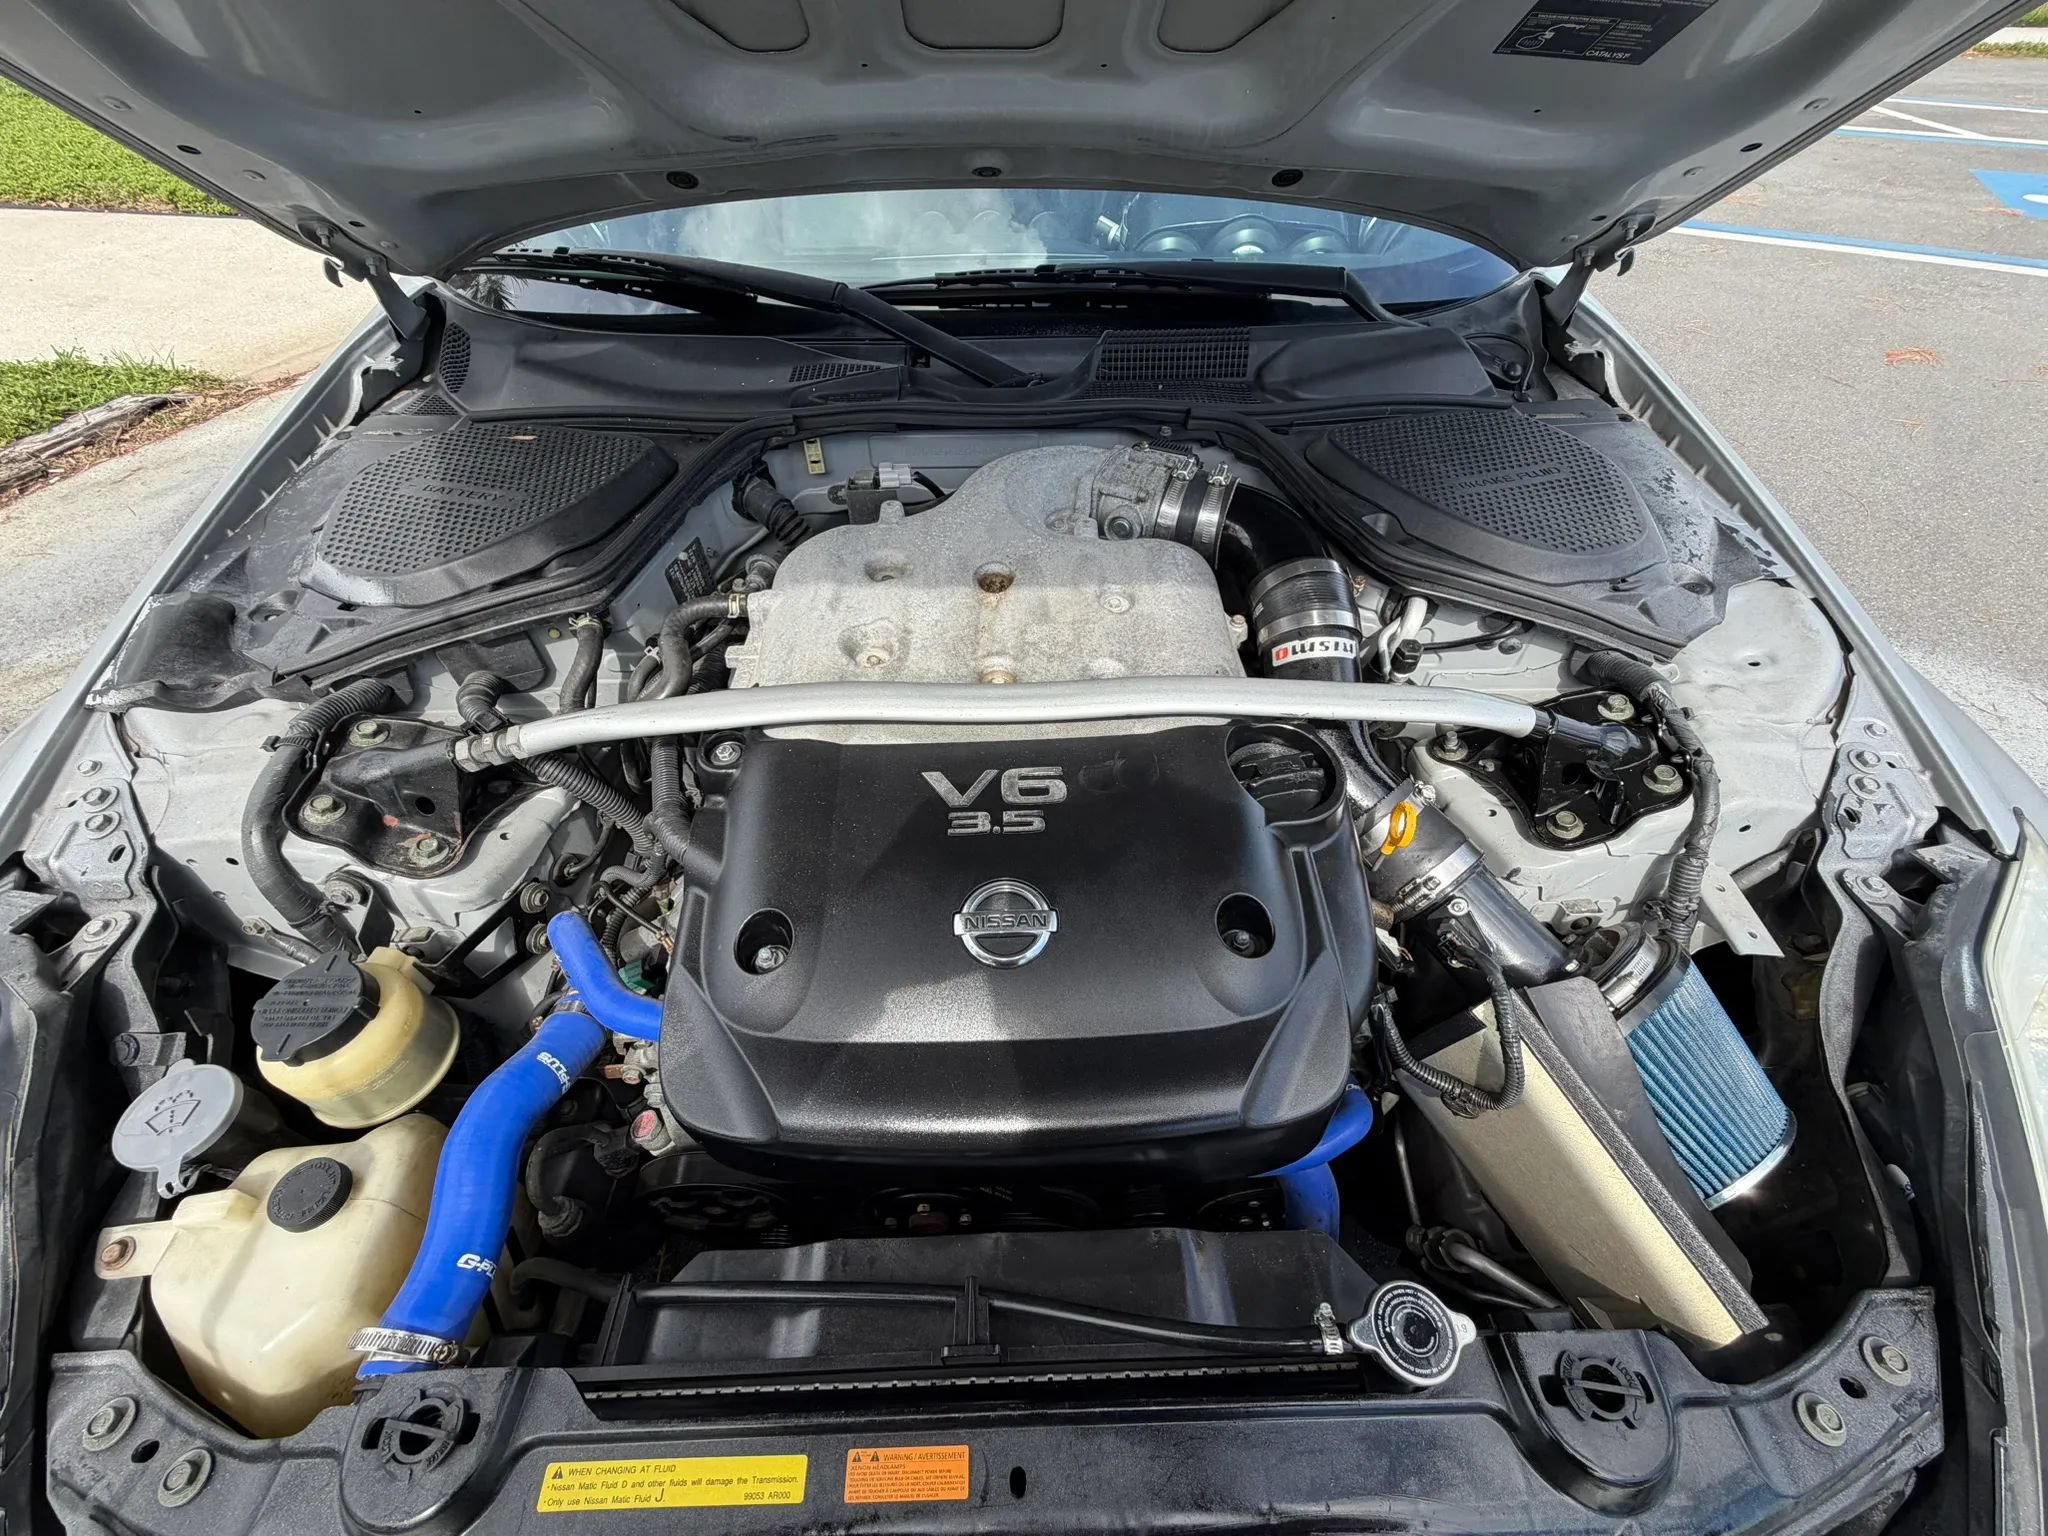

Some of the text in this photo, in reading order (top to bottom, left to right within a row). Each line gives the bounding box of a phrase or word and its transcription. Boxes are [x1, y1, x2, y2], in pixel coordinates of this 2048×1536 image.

[1517, 466, 1561, 480] FLUID
[422, 484, 504, 501] BATTERY
[921, 766, 1068, 808] V6
[947, 809, 1046, 836] 3.5
[964, 913, 1048, 930] NISSAN
[884, 1453, 913, 1461] WARNING
[919, 1452, 965, 1460] AVERTISSEMENT
[568, 1465, 676, 1476] WHEN CHANGING AT FLUID
[550, 1475, 799, 1492] Nissan Matic Fluid D and other fluids will damage the Transmission.
[547, 1498, 564, 1507] Only
[567, 1498, 580, 1506] use
[583, 1496, 608, 1505] Nissan
[611, 1495, 630, 1504] Matic
[634, 1495, 652, 1503] Fluid
[744, 1491, 791, 1500] 99053 AR000
